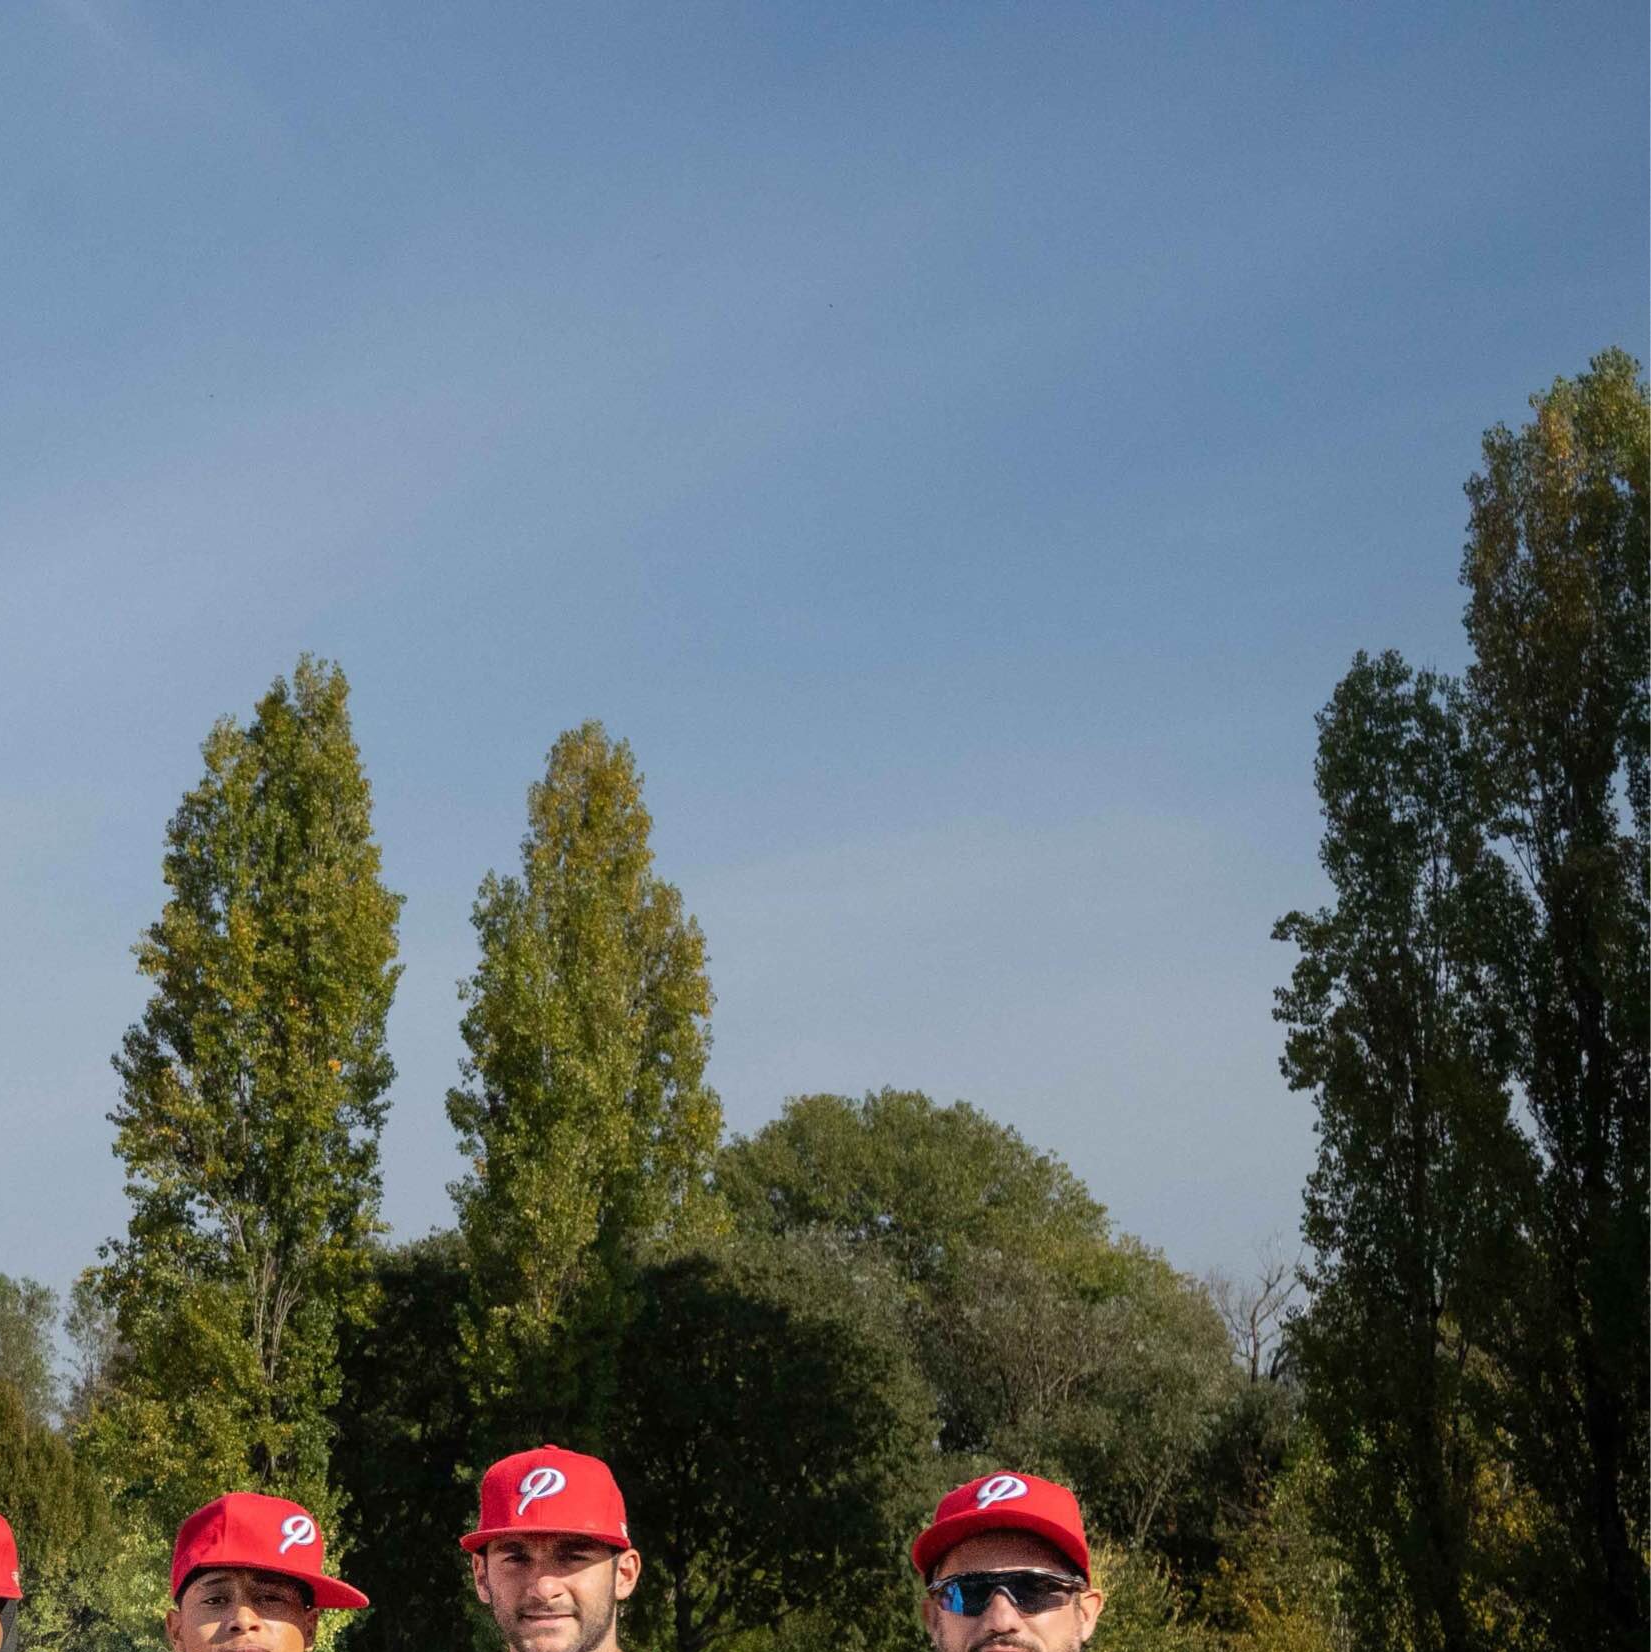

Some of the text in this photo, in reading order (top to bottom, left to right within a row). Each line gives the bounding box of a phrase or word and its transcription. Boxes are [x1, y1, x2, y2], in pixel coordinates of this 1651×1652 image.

[518, 1467, 567, 1516] P
[976, 1475, 1028, 1509] P
[279, 1514, 317, 1554] P
